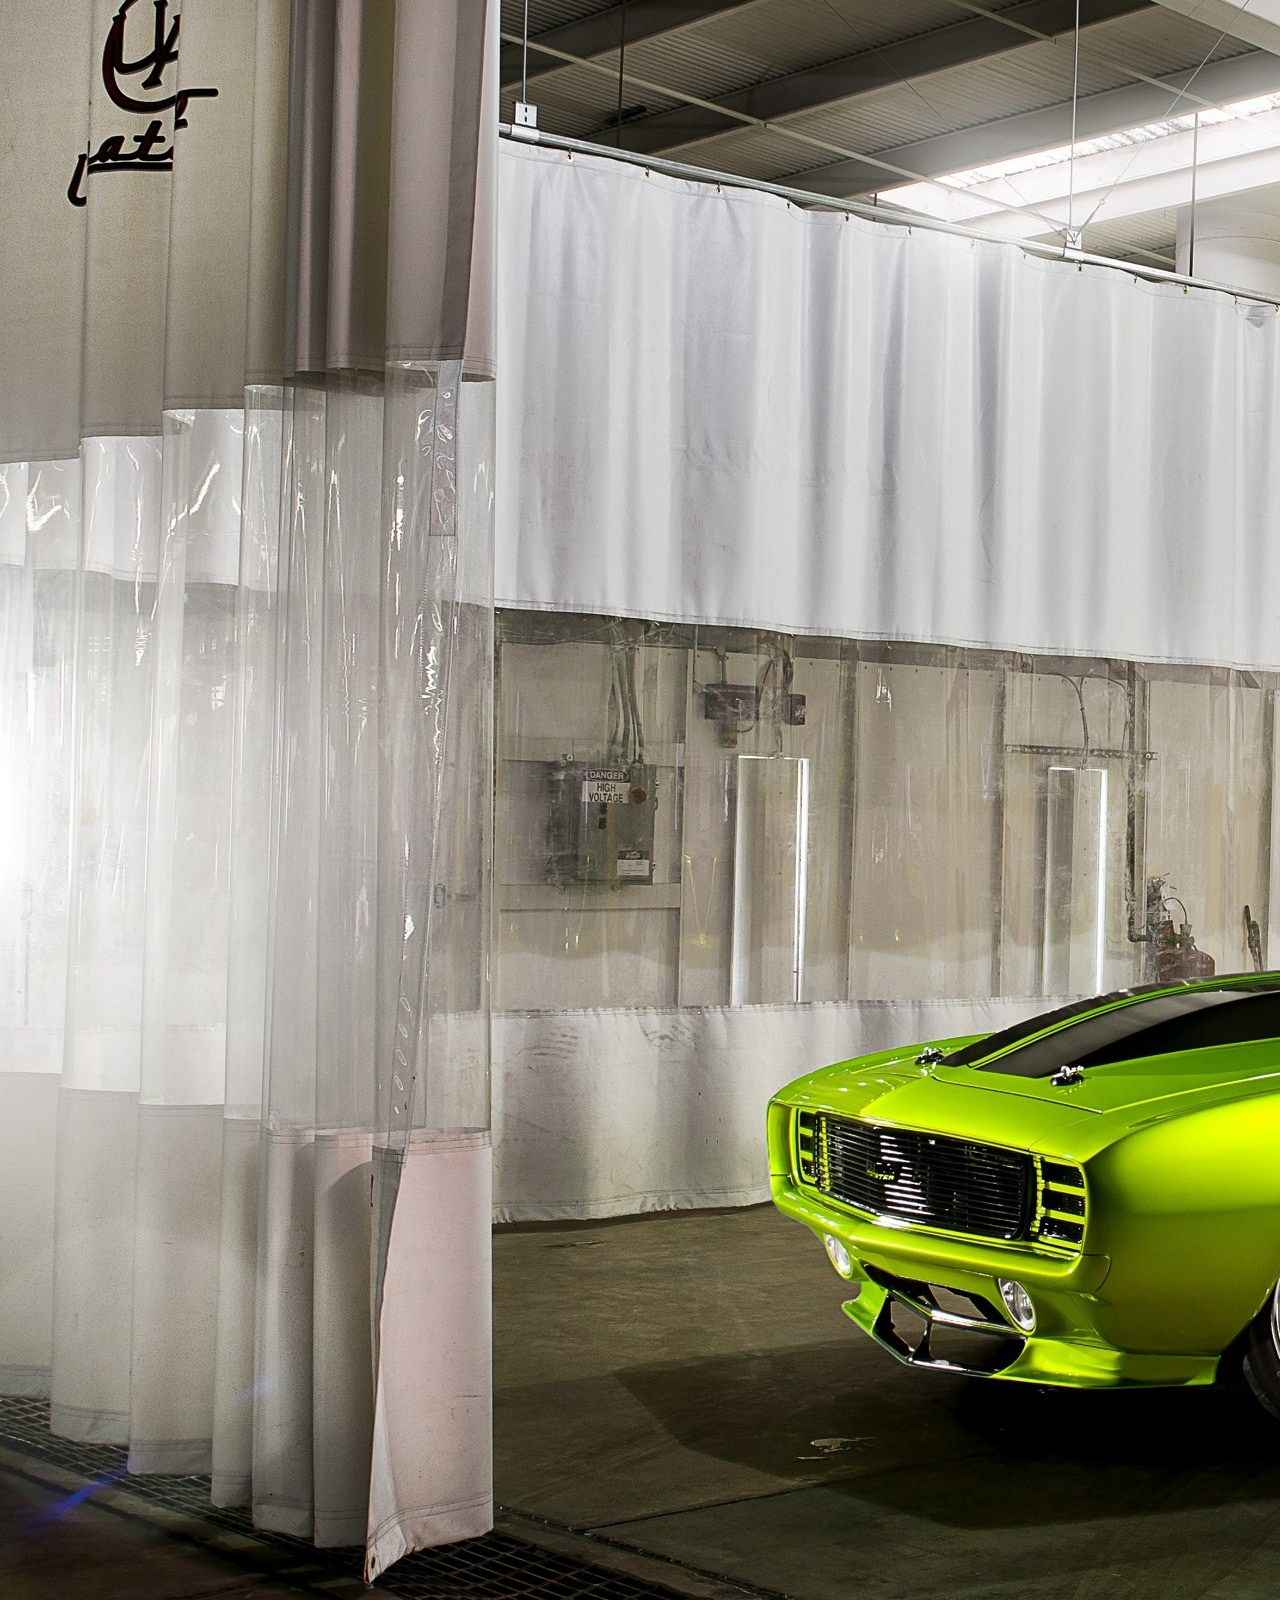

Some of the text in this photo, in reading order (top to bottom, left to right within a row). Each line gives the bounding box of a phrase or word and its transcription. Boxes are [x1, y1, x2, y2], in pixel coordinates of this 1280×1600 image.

[589, 771, 624, 780] DANGER
[596, 783, 616, 793] HIGH
[588, 793, 624, 803] VOLTAGE
